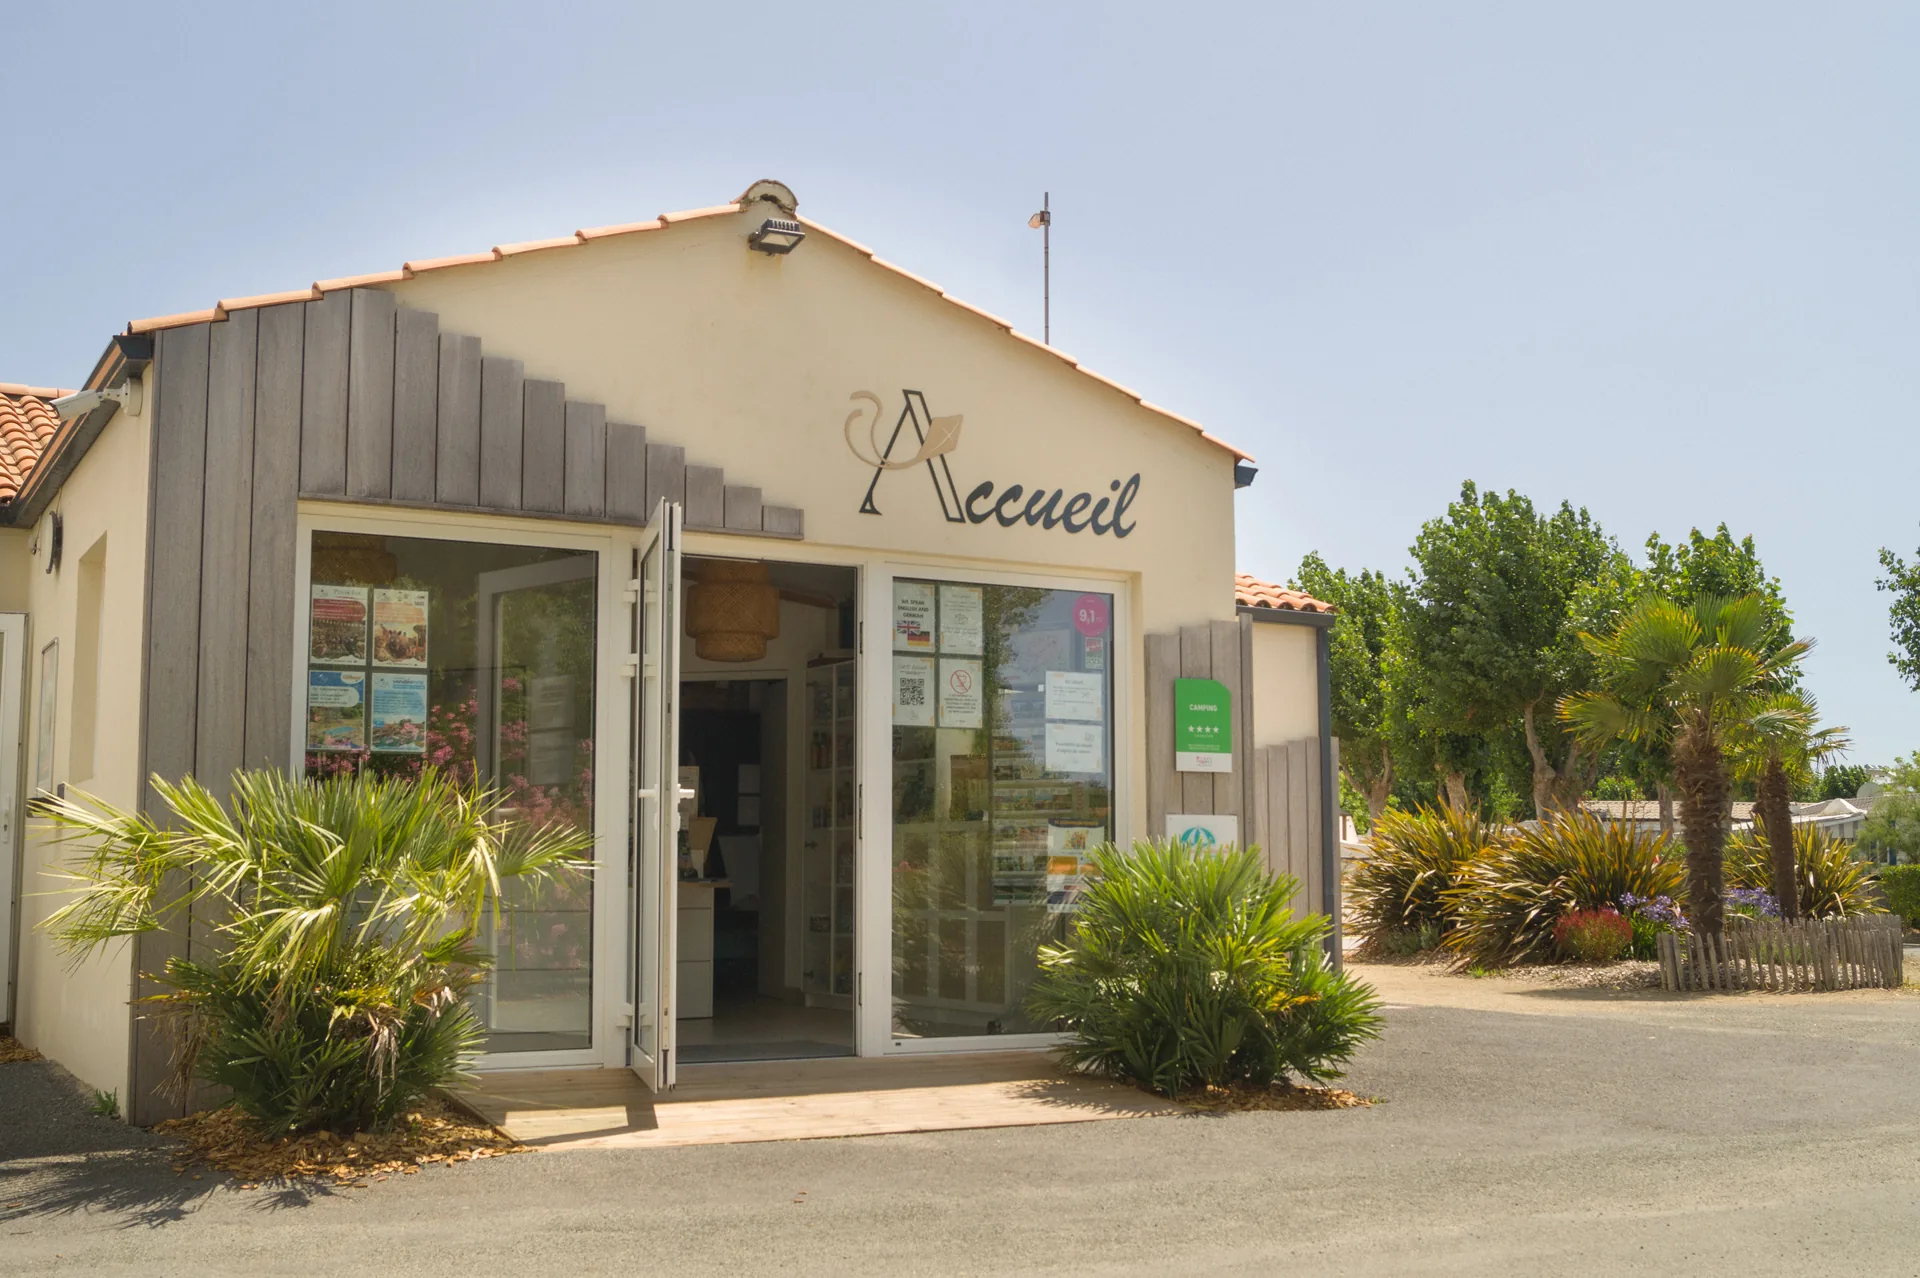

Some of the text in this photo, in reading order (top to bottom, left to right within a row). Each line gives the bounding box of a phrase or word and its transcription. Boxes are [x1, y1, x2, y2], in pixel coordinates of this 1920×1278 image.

[859, 388, 1141, 538] Accueil
[1079, 609, 1095, 625] 9,1
[1189, 703, 1218, 712] CAMPING
